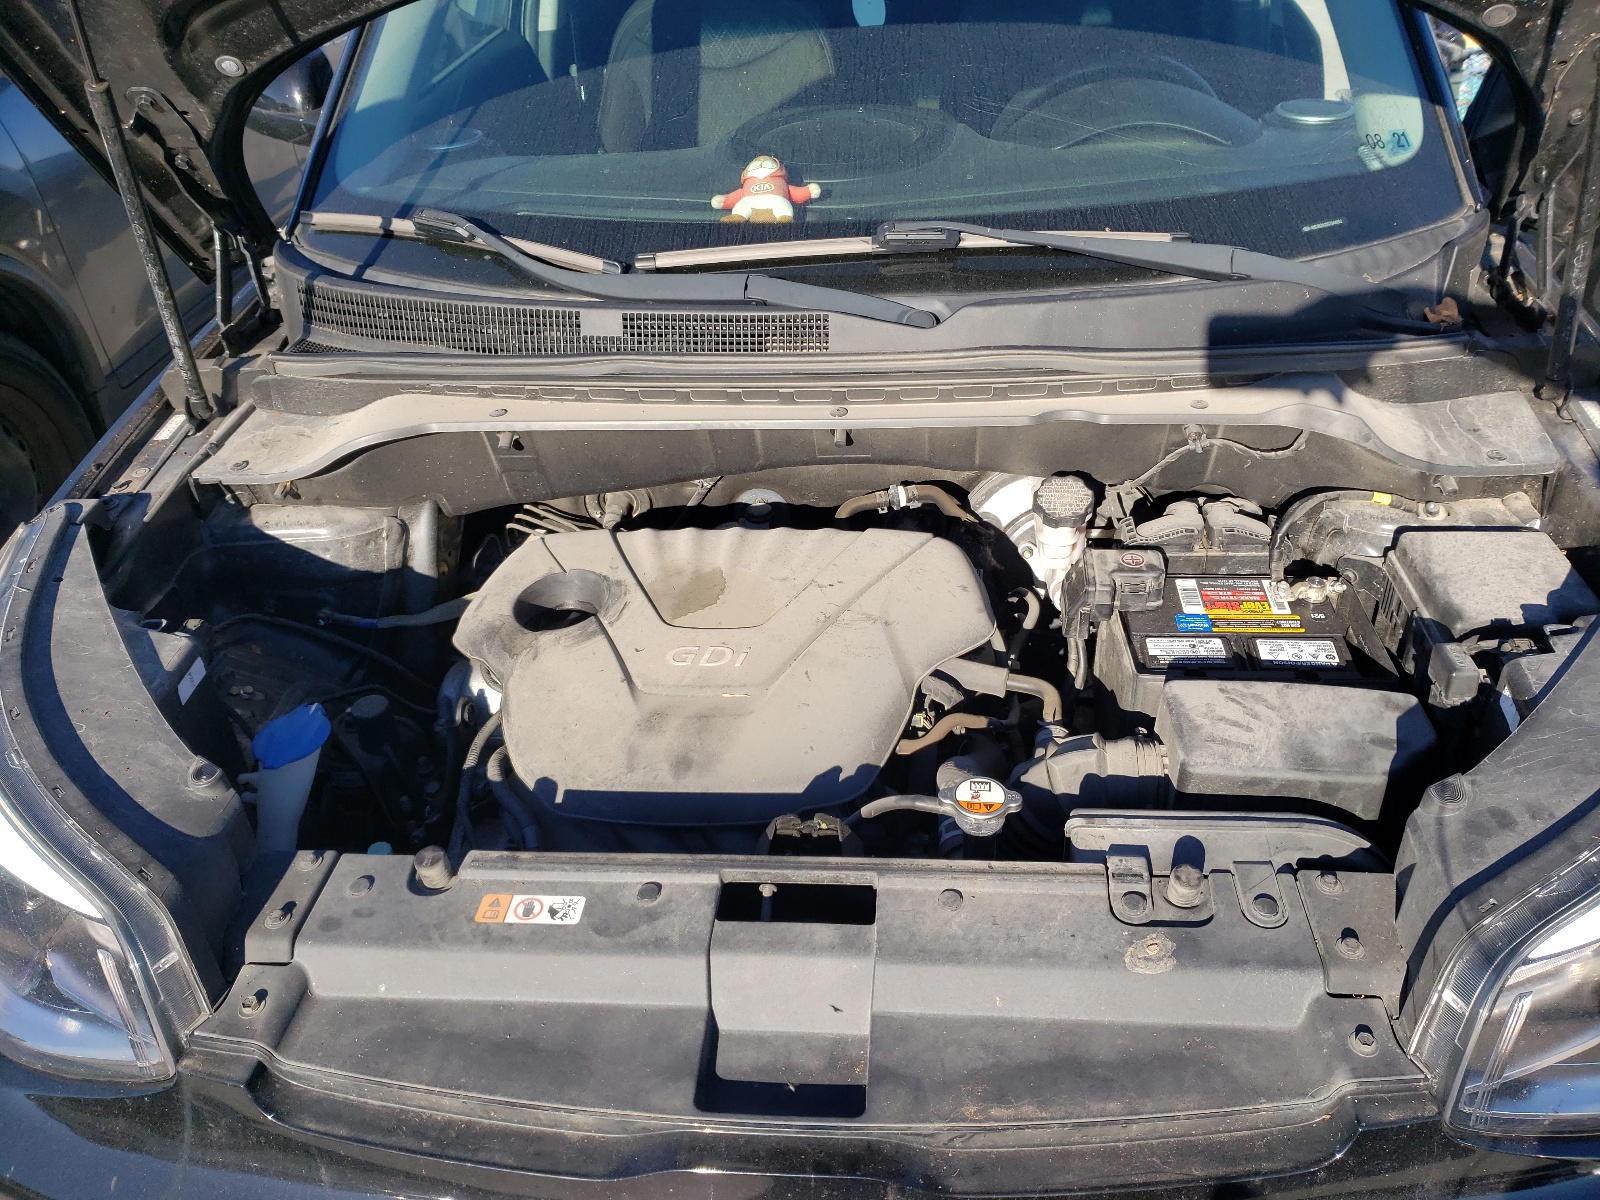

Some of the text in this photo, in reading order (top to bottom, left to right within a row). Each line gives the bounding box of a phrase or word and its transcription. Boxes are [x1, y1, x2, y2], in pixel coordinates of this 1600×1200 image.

[1365, 131, 1410, 149] 08 21
[667, 645, 751, 667] GDi
